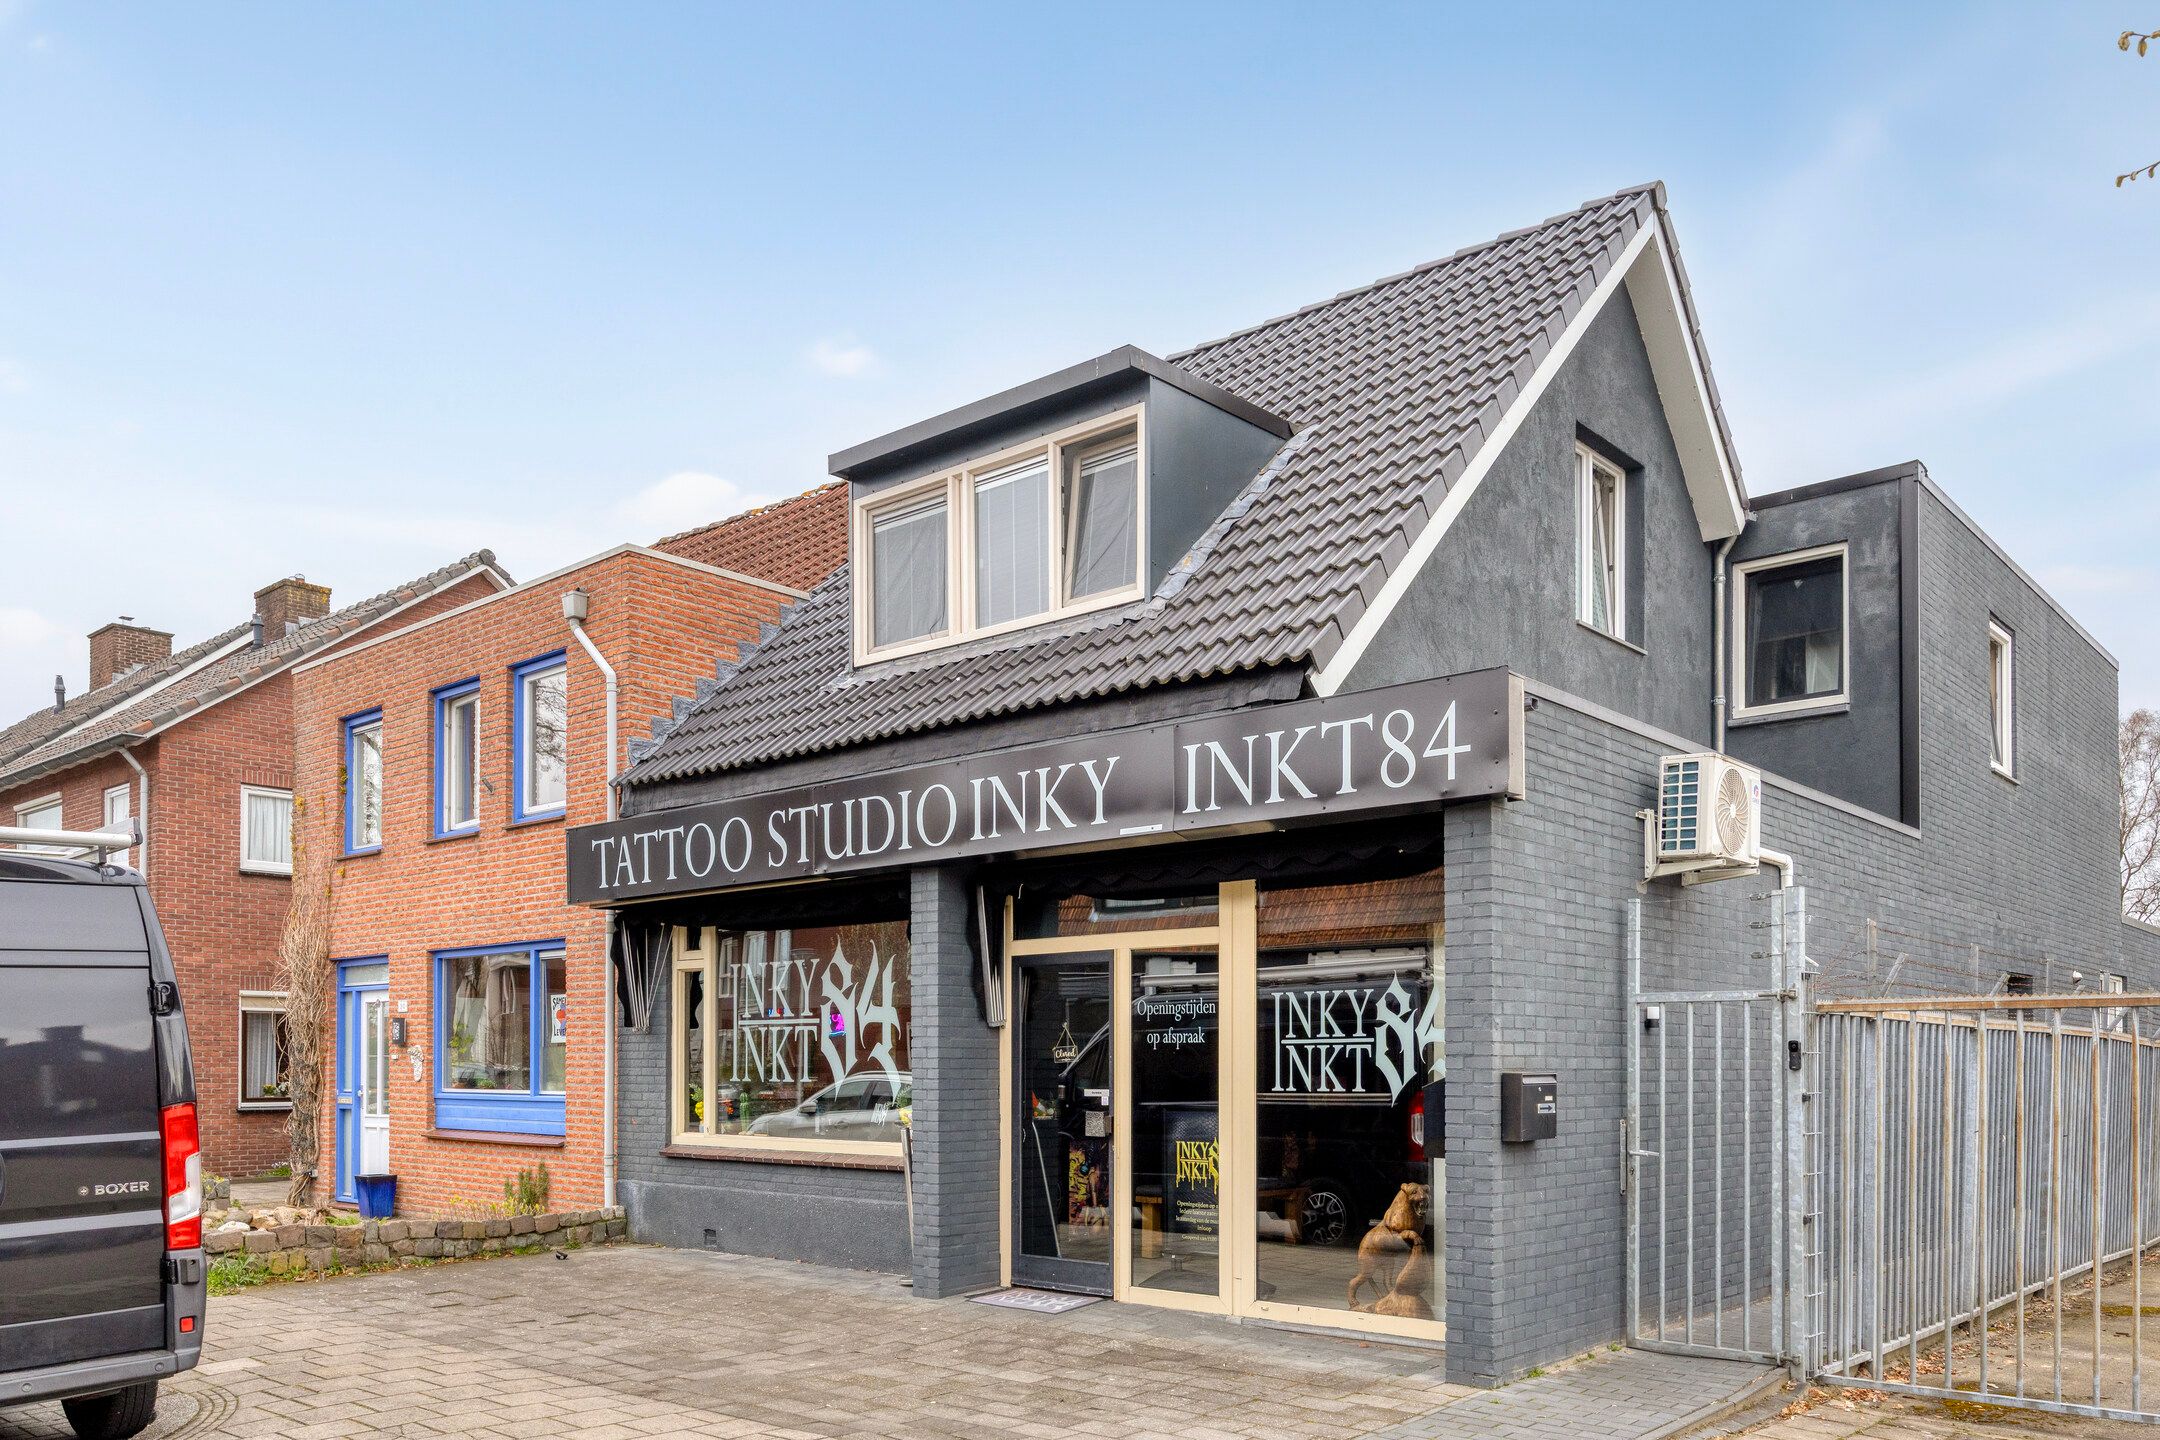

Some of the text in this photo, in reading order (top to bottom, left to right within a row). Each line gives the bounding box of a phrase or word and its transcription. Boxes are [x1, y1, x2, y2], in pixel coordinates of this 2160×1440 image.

[591, 817, 753, 889] TATTOO
[768, 784, 957, 867] STUDIO
[969, 756, 1120, 841] INKY
[730, 959, 820, 1018] INKY
[820, 934, 901, 1105] 84
[1137, 997, 1216, 1021] Openingstijden
[1271, 989, 1374, 1038] INKY
[1147, 1027, 1205, 1050] op afspraak
[1176, 1141, 1210, 1159] INKY
[94, 1181, 150, 1195] BOXER
